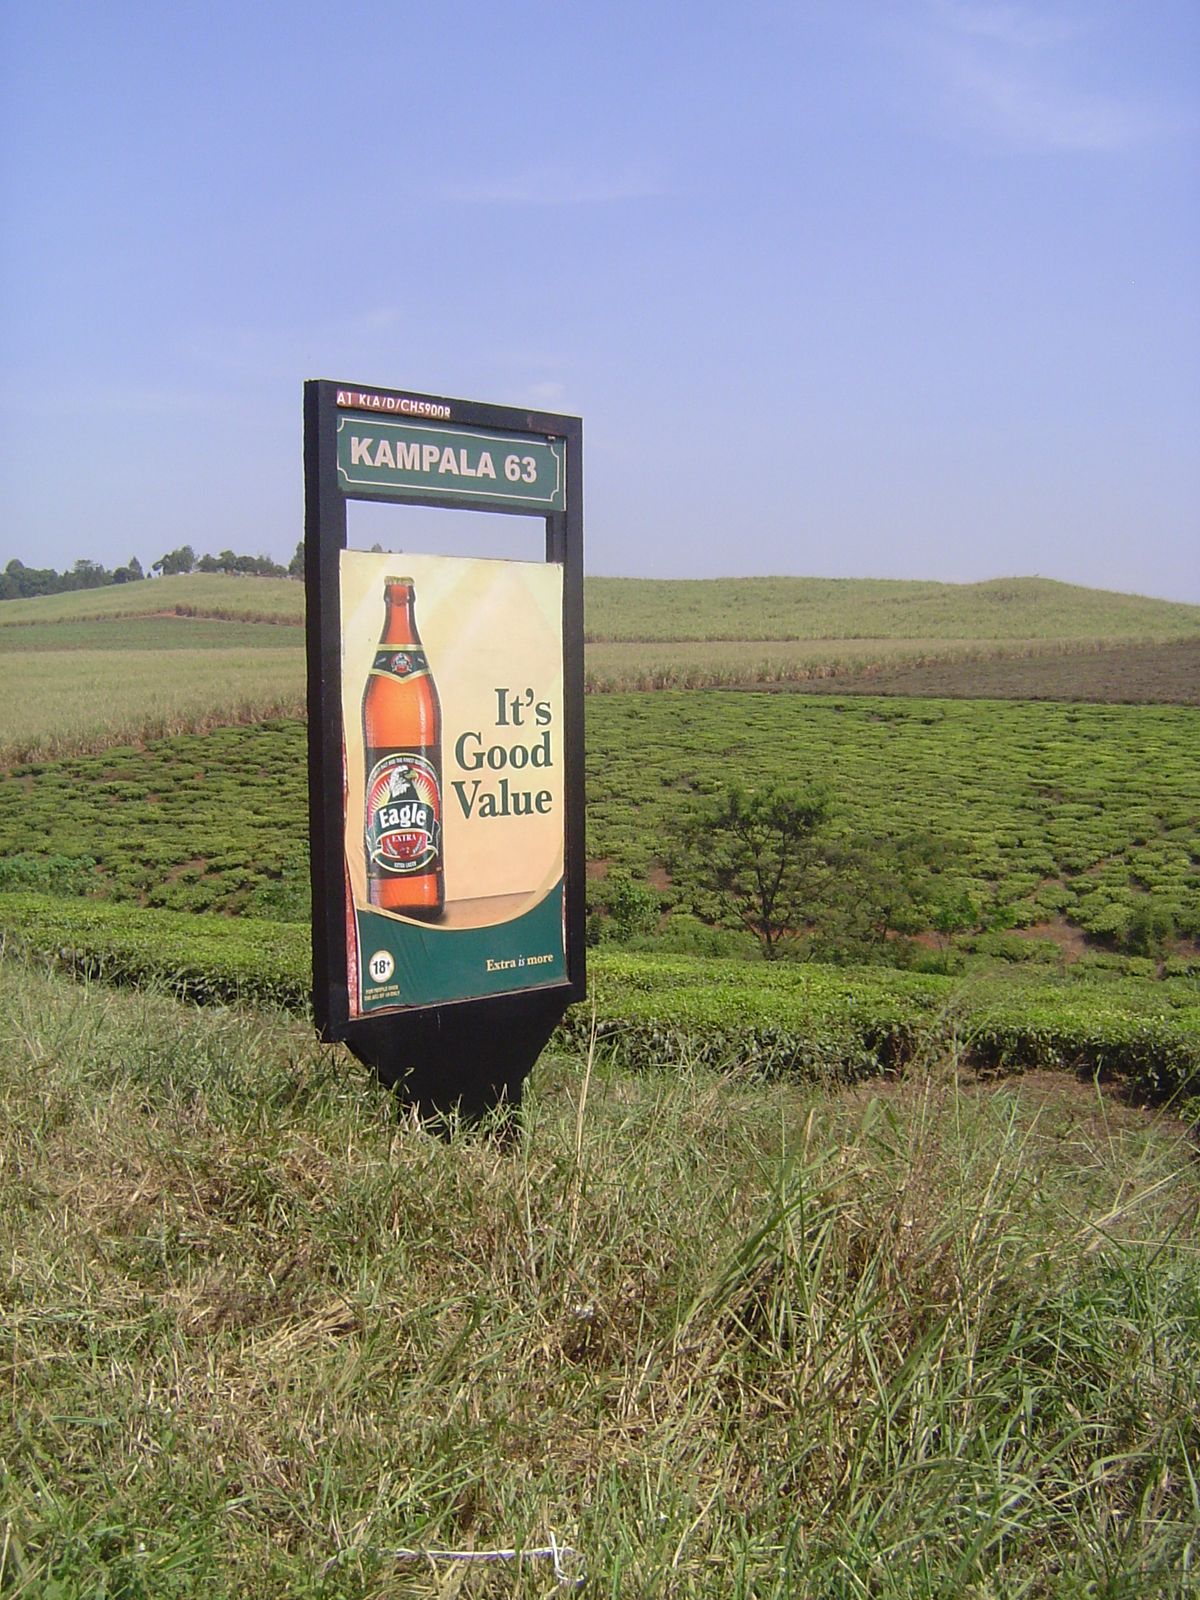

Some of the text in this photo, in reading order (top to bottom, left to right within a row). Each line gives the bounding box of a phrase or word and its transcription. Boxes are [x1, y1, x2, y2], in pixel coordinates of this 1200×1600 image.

[351, 436, 537, 483] KAMPALA 63
[494, 687, 552, 726] It's
[455, 730, 553, 771] Good
[451, 778, 552, 819] Value
[379, 803, 427, 829] Eagle
[391, 833, 417, 843] EXTRA
[373, 959, 391, 975] 18+
[486, 954, 553, 971] Extra is more
